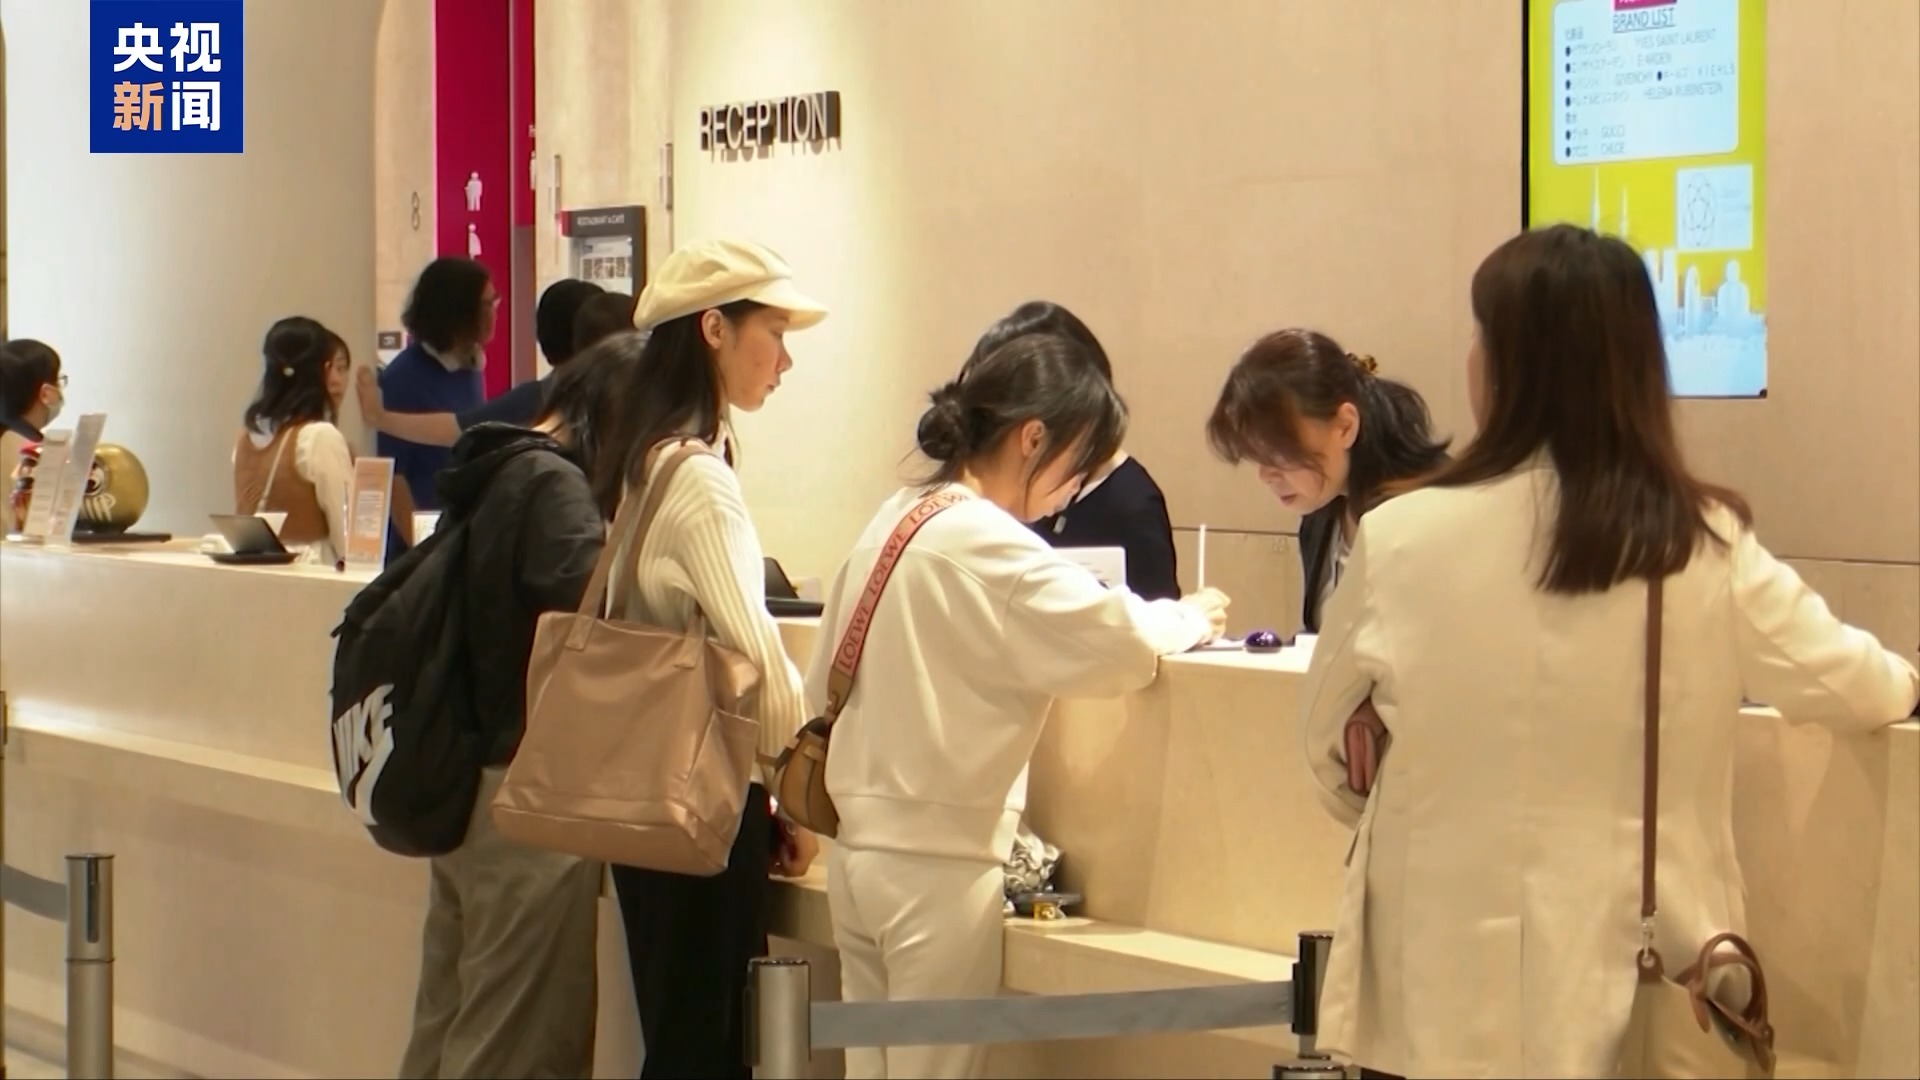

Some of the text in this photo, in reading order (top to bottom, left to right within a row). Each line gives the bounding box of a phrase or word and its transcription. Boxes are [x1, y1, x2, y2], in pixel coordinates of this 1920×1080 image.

[1613, 7, 1674, 31] BRAND LIST
[1681, 29, 1716, 44] LAURENT
[700, 91, 830, 152] RECEPTION
[838, 605, 869, 671] LOEWE
[869, 532, 904, 596] LOEWE
[331, 683, 395, 785] NIKE
